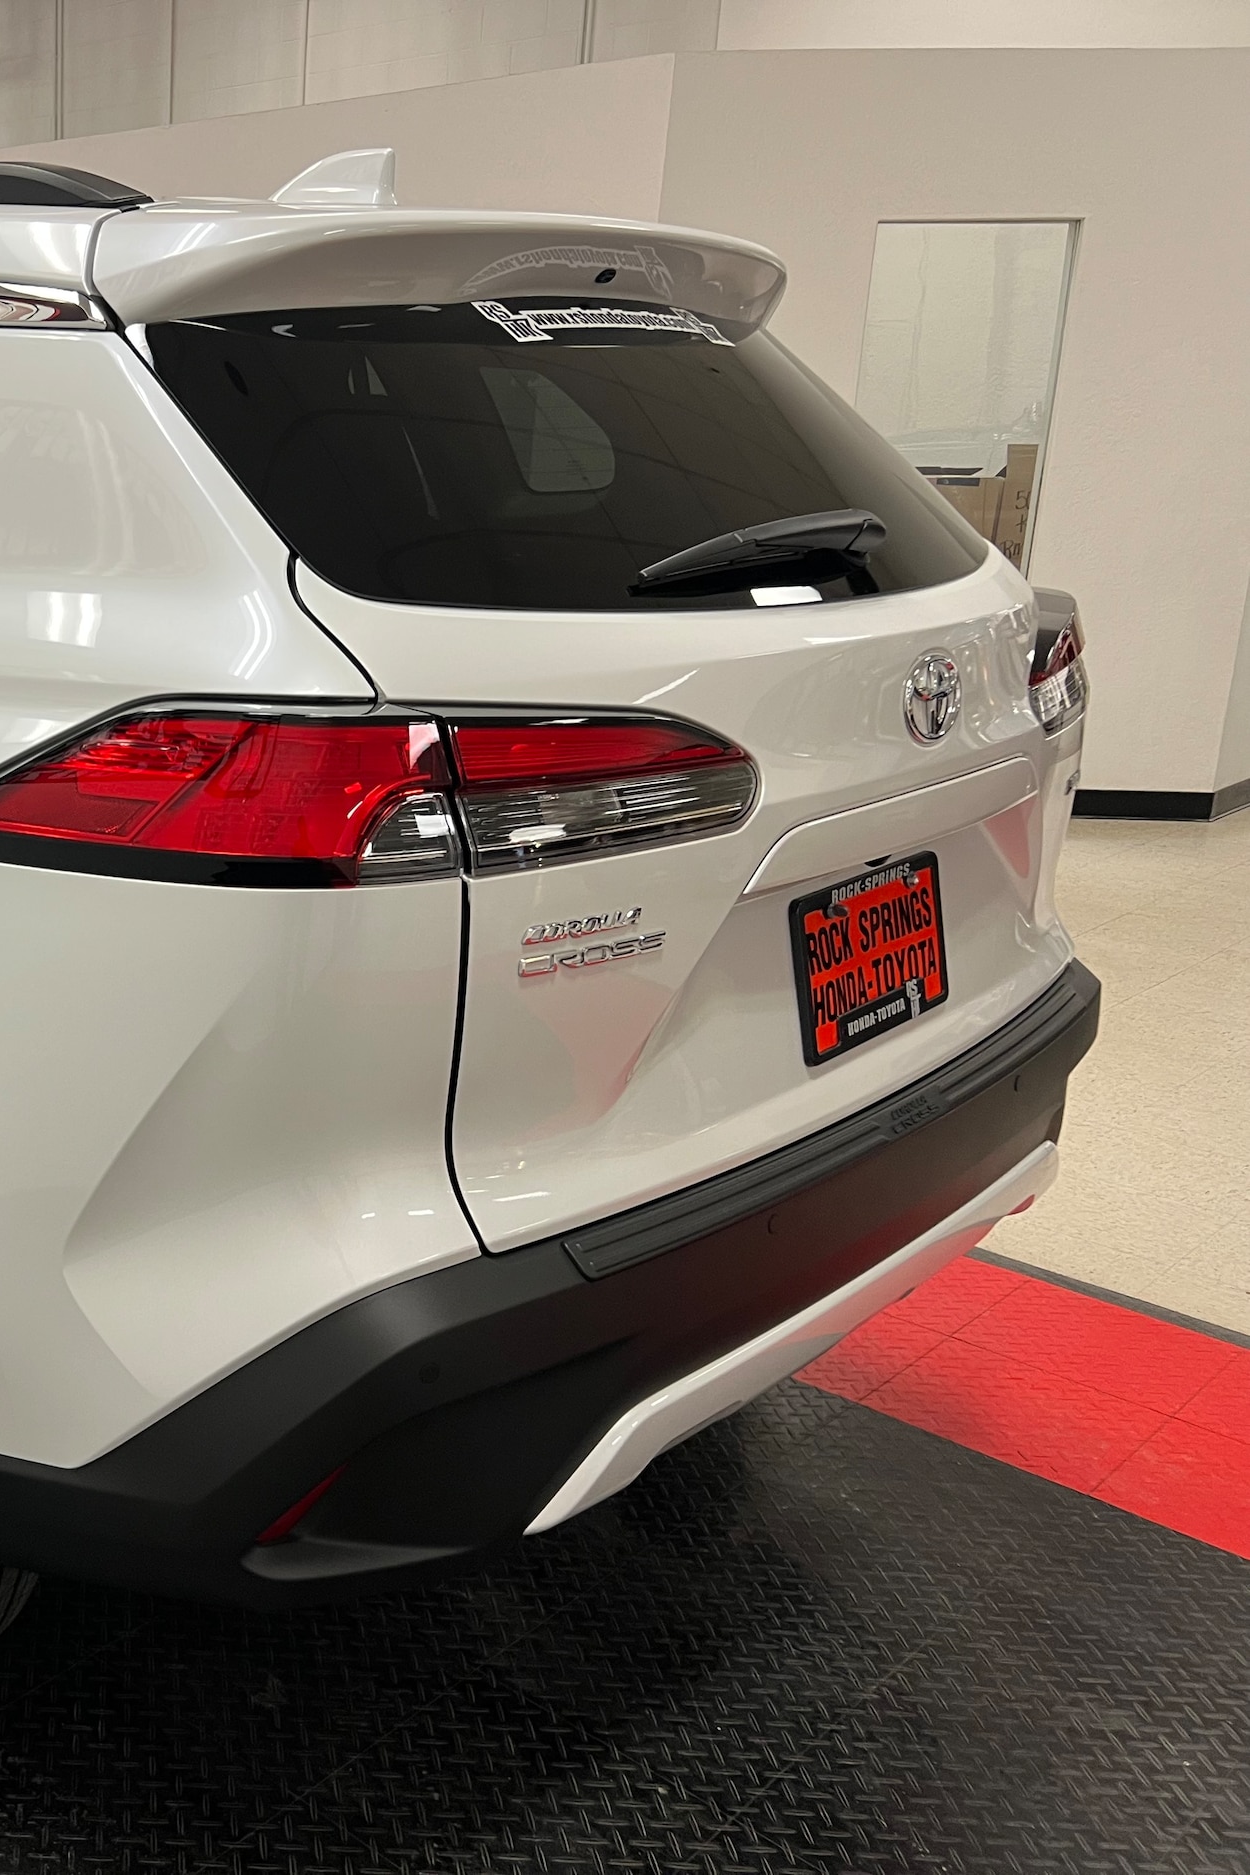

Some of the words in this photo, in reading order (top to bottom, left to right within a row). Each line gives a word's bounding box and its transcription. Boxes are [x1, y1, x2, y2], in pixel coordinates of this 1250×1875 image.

[521, 906, 642, 946] COROLLA
[806, 916, 854, 976] ROCK
[858, 887, 933, 953] SPRINGS
[518, 930, 667, 977] CROSS
[813, 936, 938, 1027] HONDA-TOYOTA
[847, 997, 906, 1037] HONDA-TOYOTA
